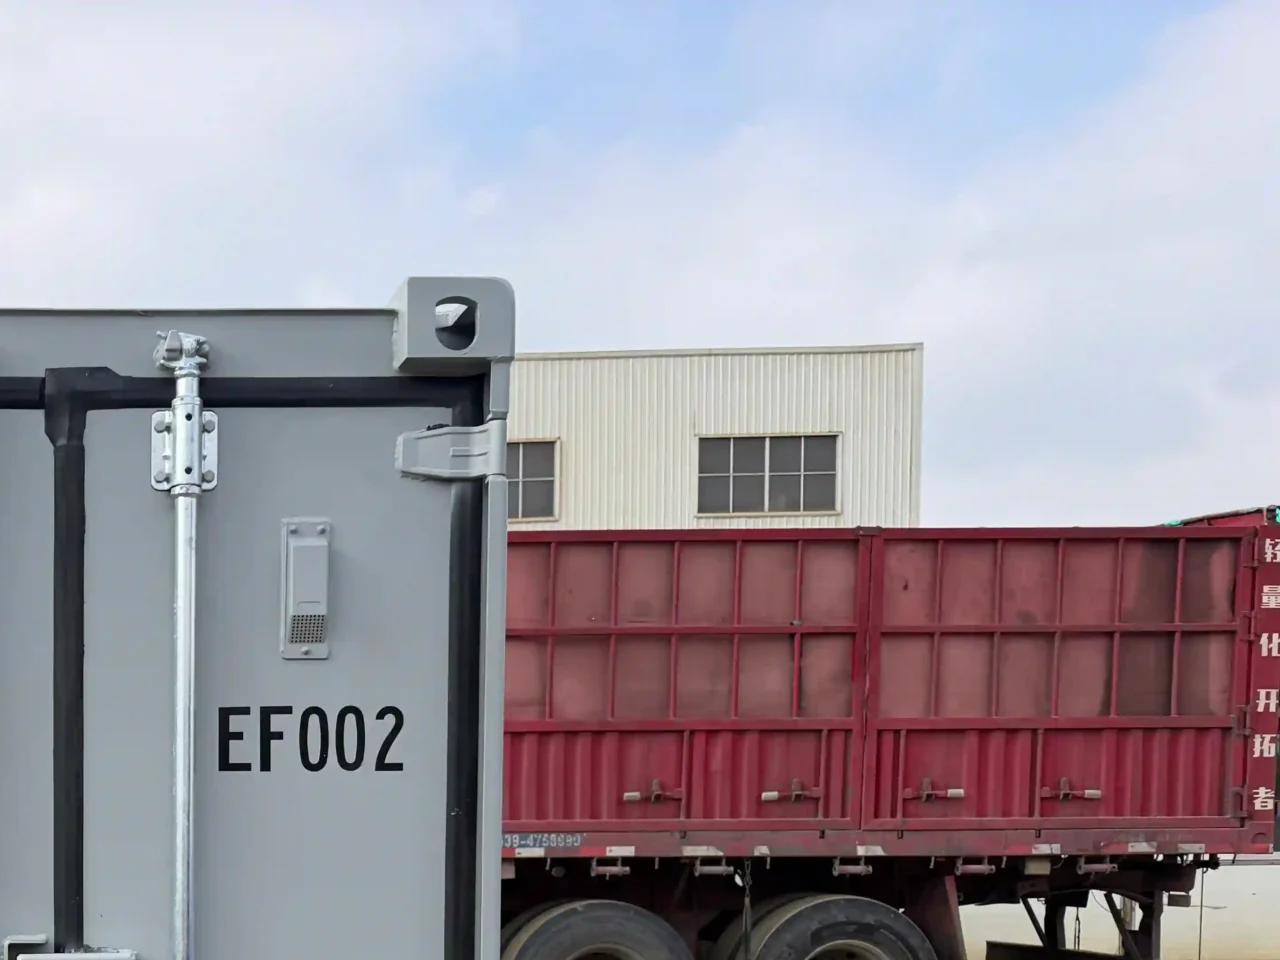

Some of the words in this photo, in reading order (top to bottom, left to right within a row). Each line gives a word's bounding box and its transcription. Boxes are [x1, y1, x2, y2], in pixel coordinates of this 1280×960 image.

[217, 705, 405, 773] EF002
[1252, 538, 1280, 811] 轻量化开拓者
